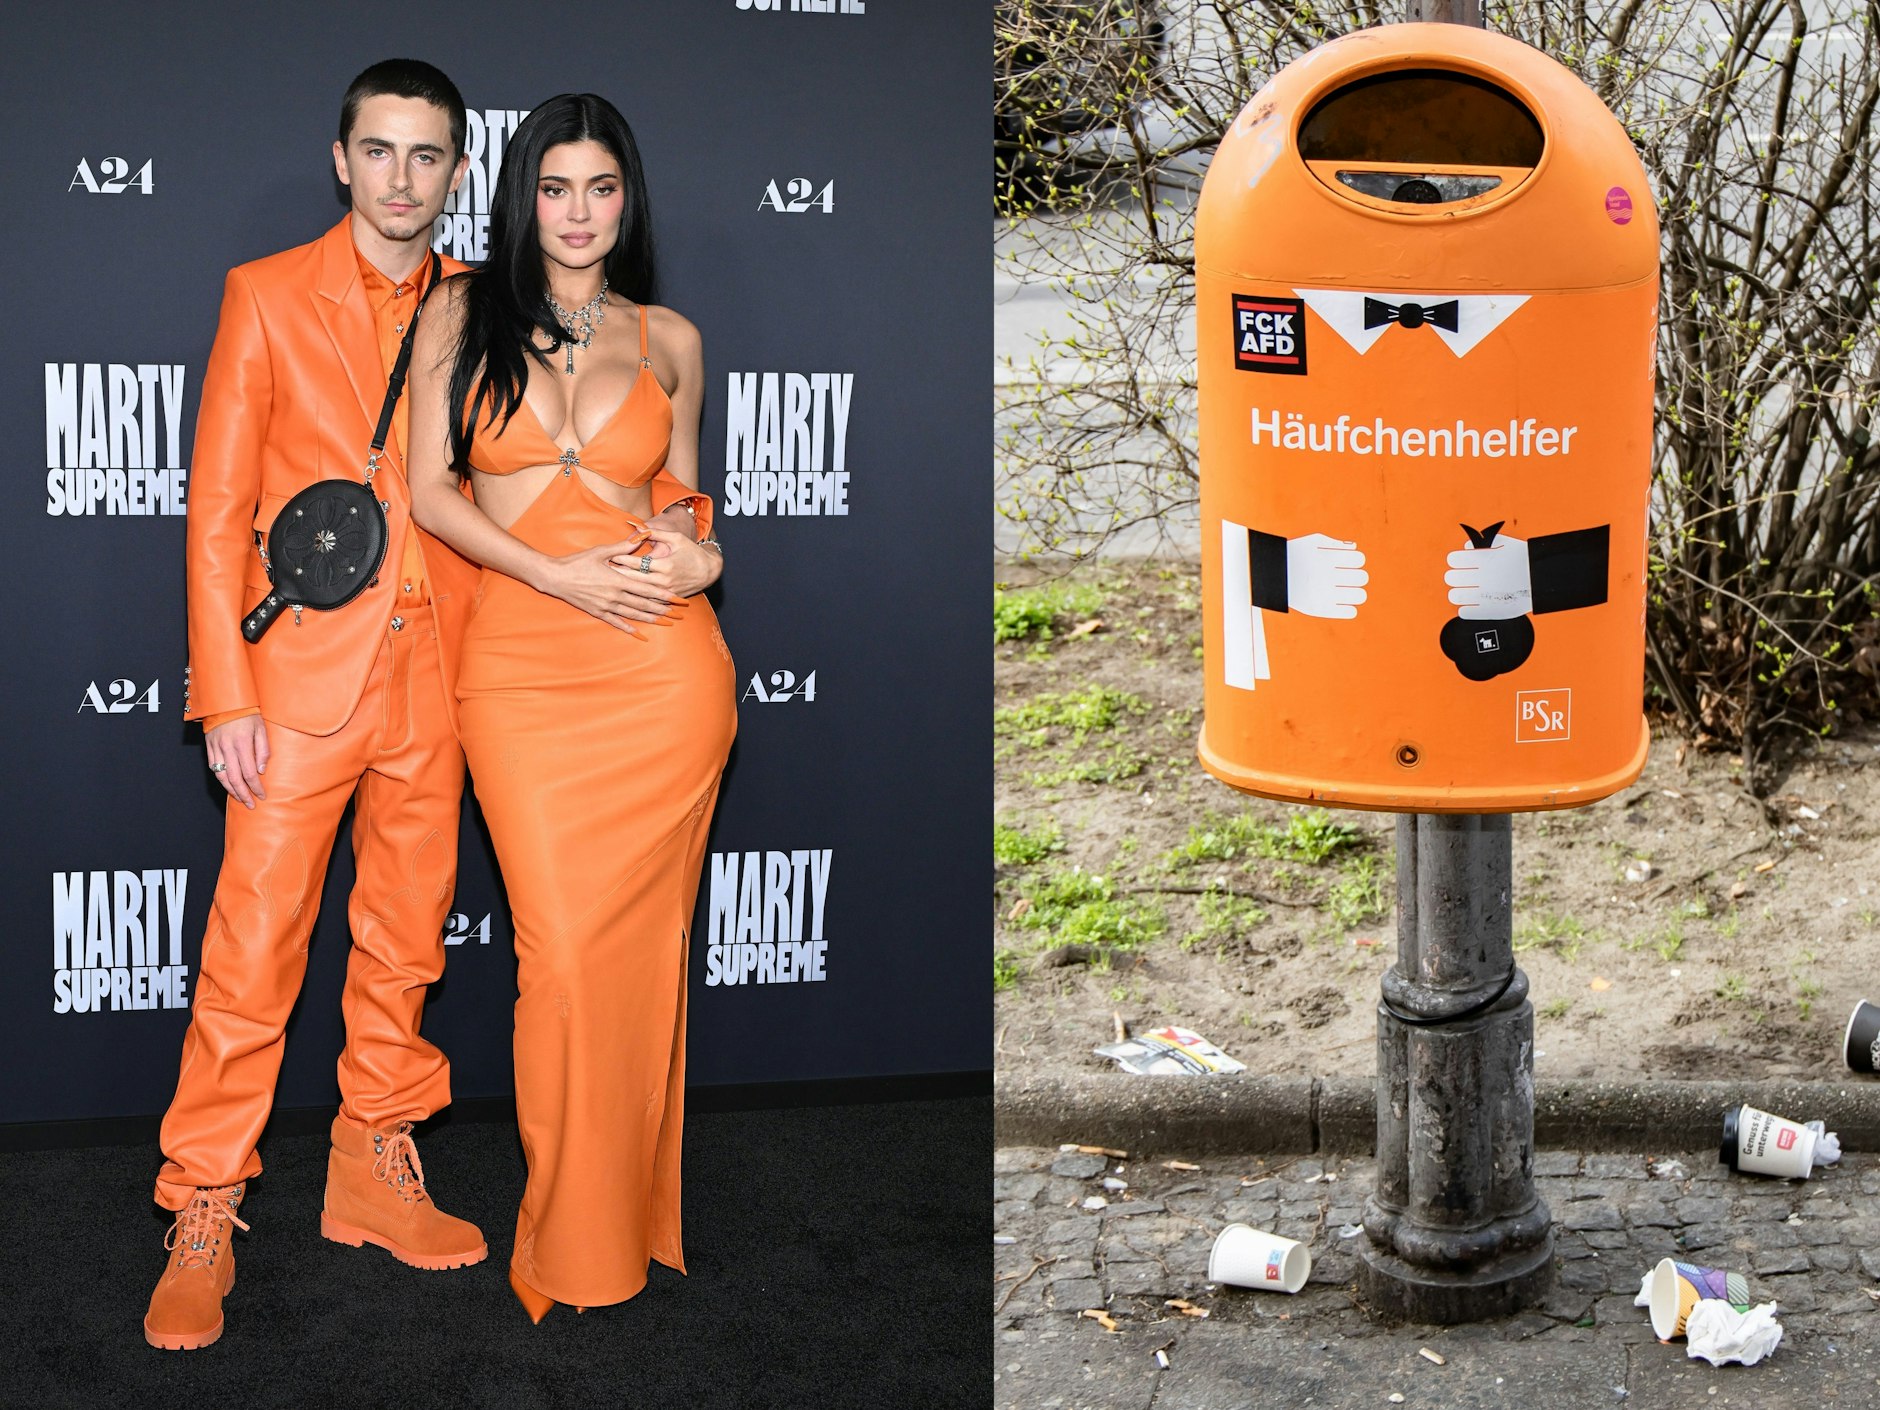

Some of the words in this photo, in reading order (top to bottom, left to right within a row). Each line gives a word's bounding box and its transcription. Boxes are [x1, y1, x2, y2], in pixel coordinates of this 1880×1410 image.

[68, 156, 155, 195] A24
[757, 177, 836, 214] A24
[1240, 311, 1295, 334] FCK
[1241, 332, 1295, 355] AFD
[45, 362, 186, 469] MARTY
[725, 371, 854, 472] MARTY
[1251, 407, 1578, 458] Häufchenhelfer
[46, 467, 187, 517] SUPREME
[723, 470, 851, 517] SUPREME
[77, 678, 161, 714] A24
[741, 669, 818, 703] A24
[1522, 699, 1565, 732] BSR
[709, 848, 833, 945] MARTY
[52, 868, 189, 970] MARTY
[443, 912, 493, 946] 24
[705, 940, 829, 987] SUPREME
[53, 964, 189, 1014] SUPREME
[1742, 1121, 1760, 1155] Genuss
